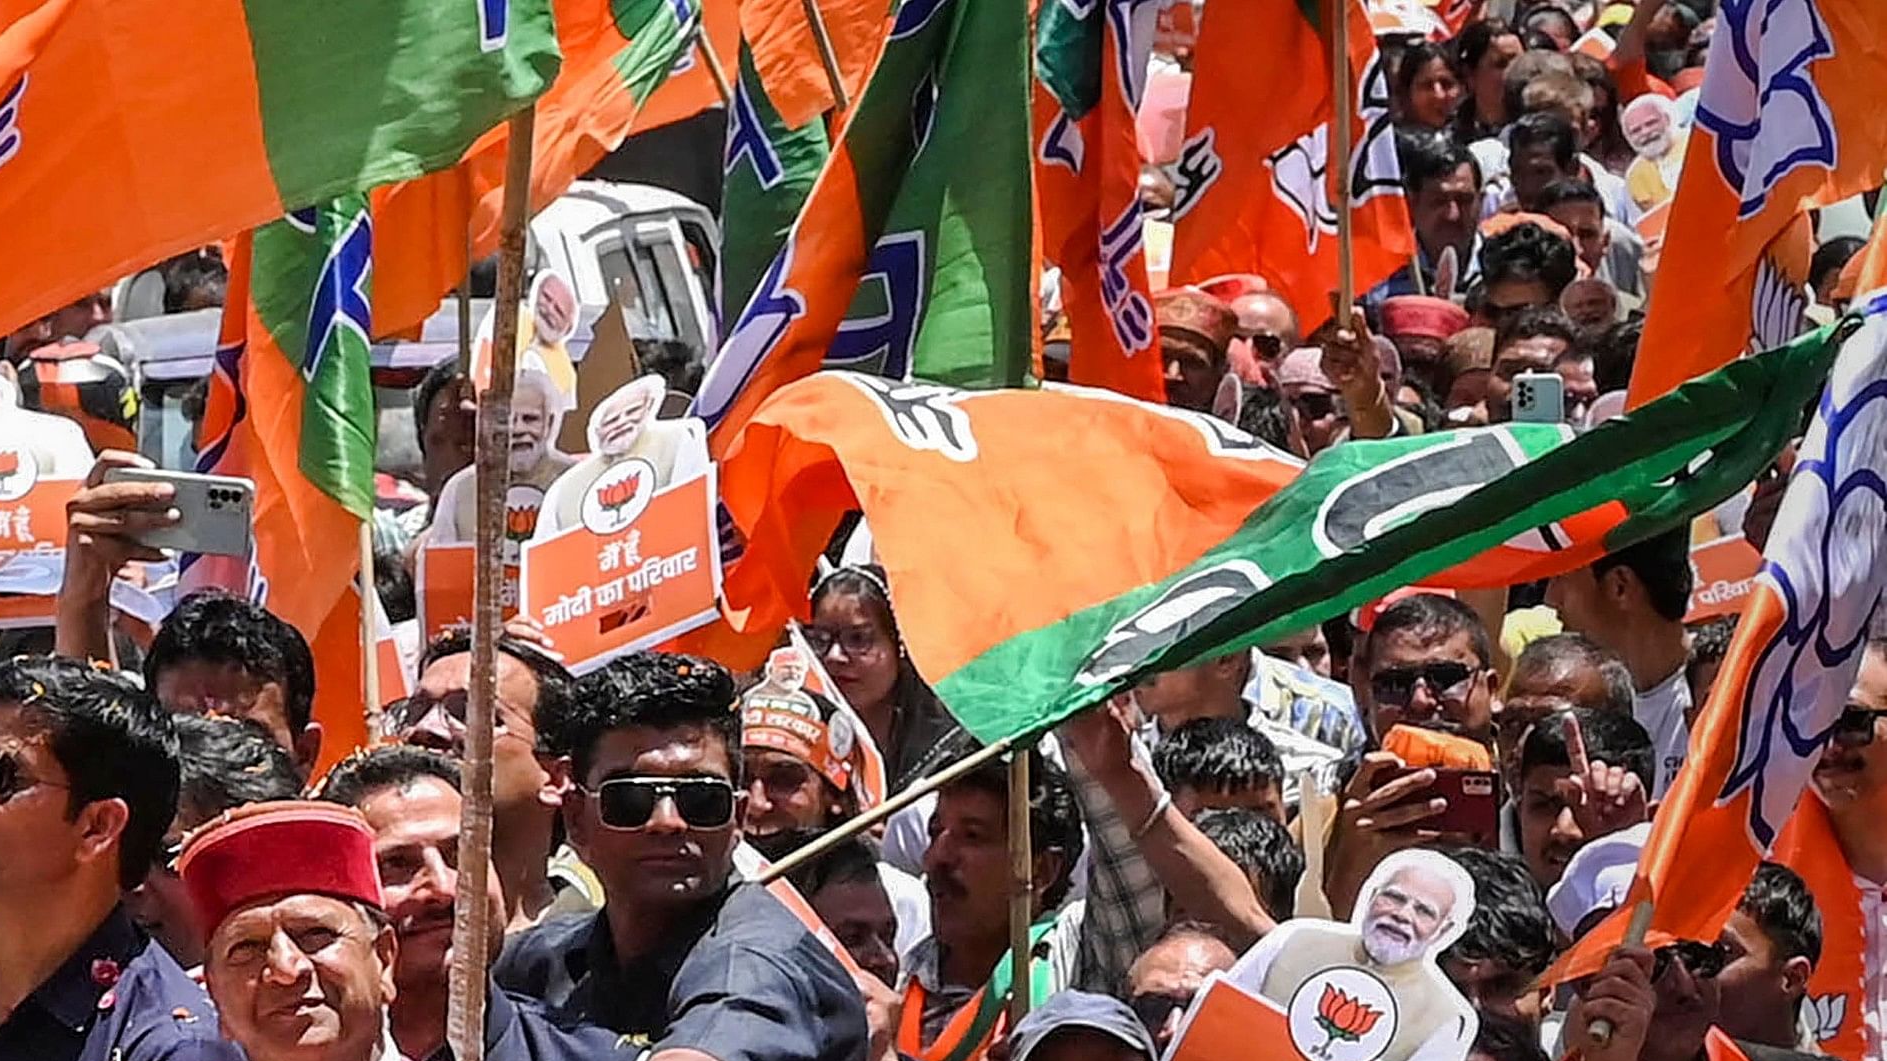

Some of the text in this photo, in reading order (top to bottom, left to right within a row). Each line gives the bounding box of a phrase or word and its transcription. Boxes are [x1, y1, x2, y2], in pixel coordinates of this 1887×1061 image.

[597, 540, 623, 571] मैं
[542, 585, 592, 625] मोदी
[594, 576, 625, 606] का
[626, 546, 698, 591] परिवार
